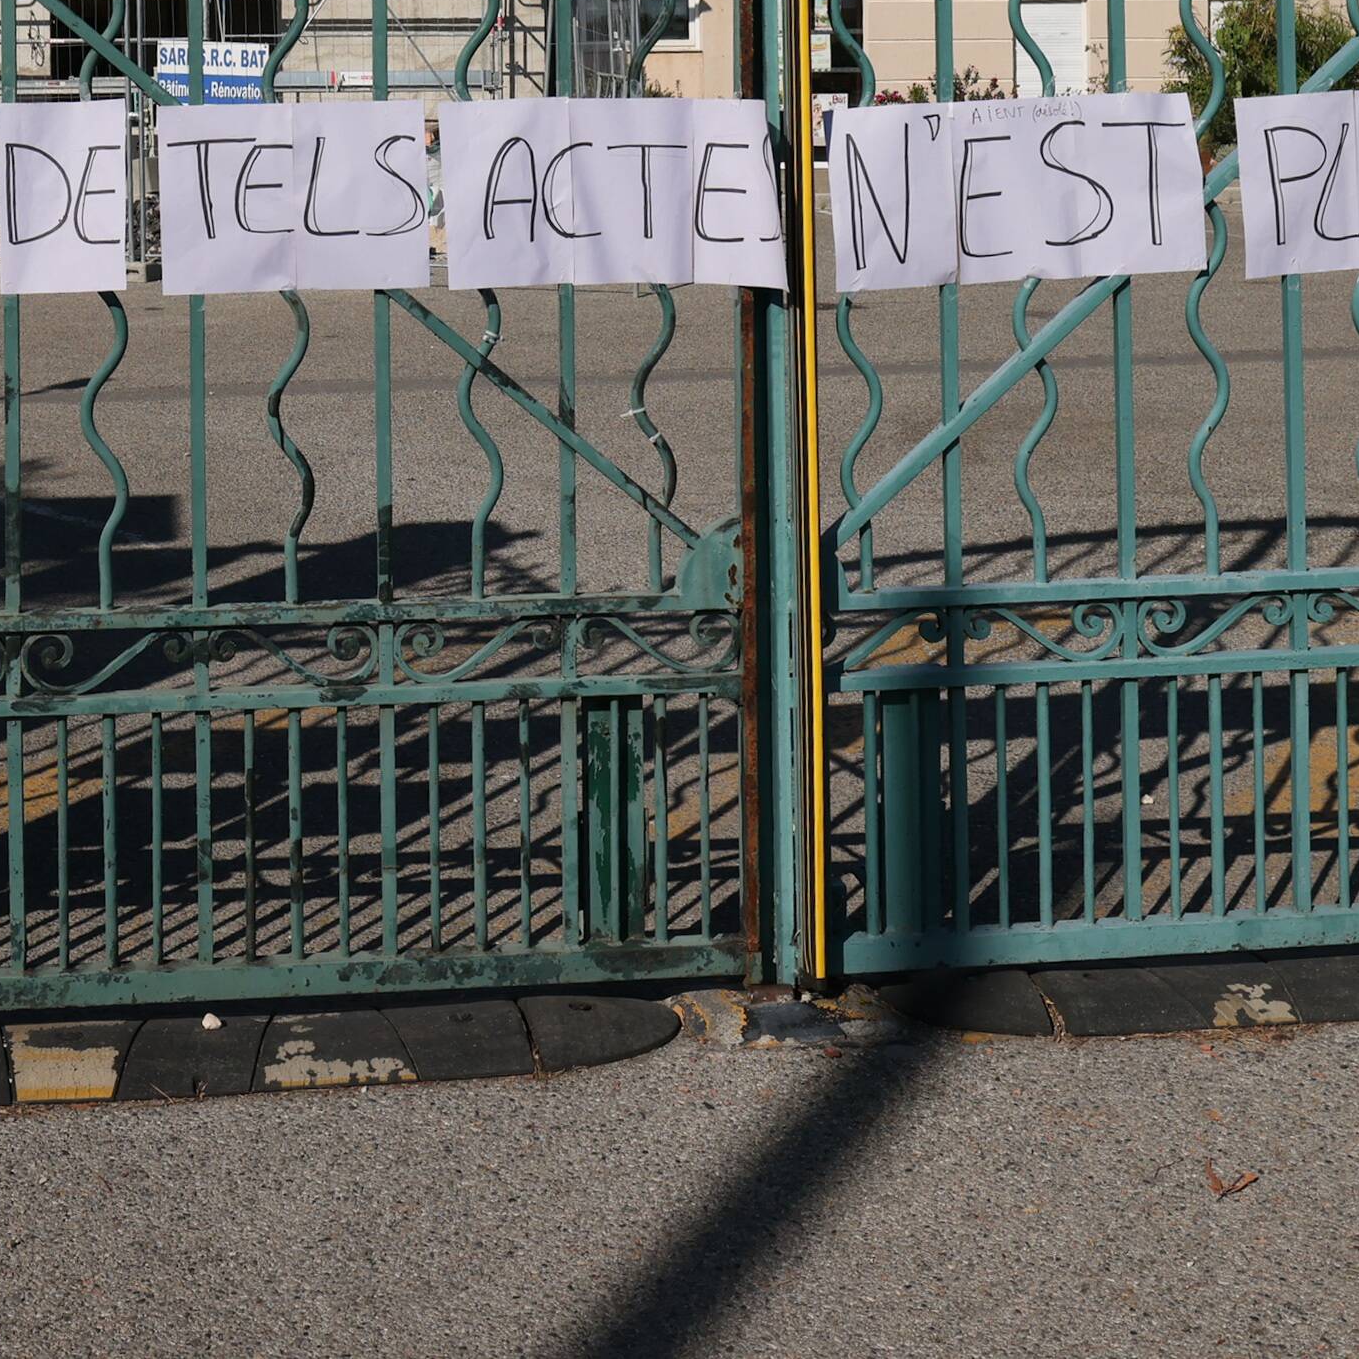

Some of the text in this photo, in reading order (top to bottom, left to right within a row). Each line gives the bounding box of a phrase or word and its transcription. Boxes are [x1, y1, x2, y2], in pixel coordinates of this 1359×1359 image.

[241, 49, 265, 67] BAT
[211, 80, 262, 99] Rénovatio
[5, 143, 122, 246] DE
[166, 134, 426, 240] TELS
[844, 112, 1186, 270] N'EST
